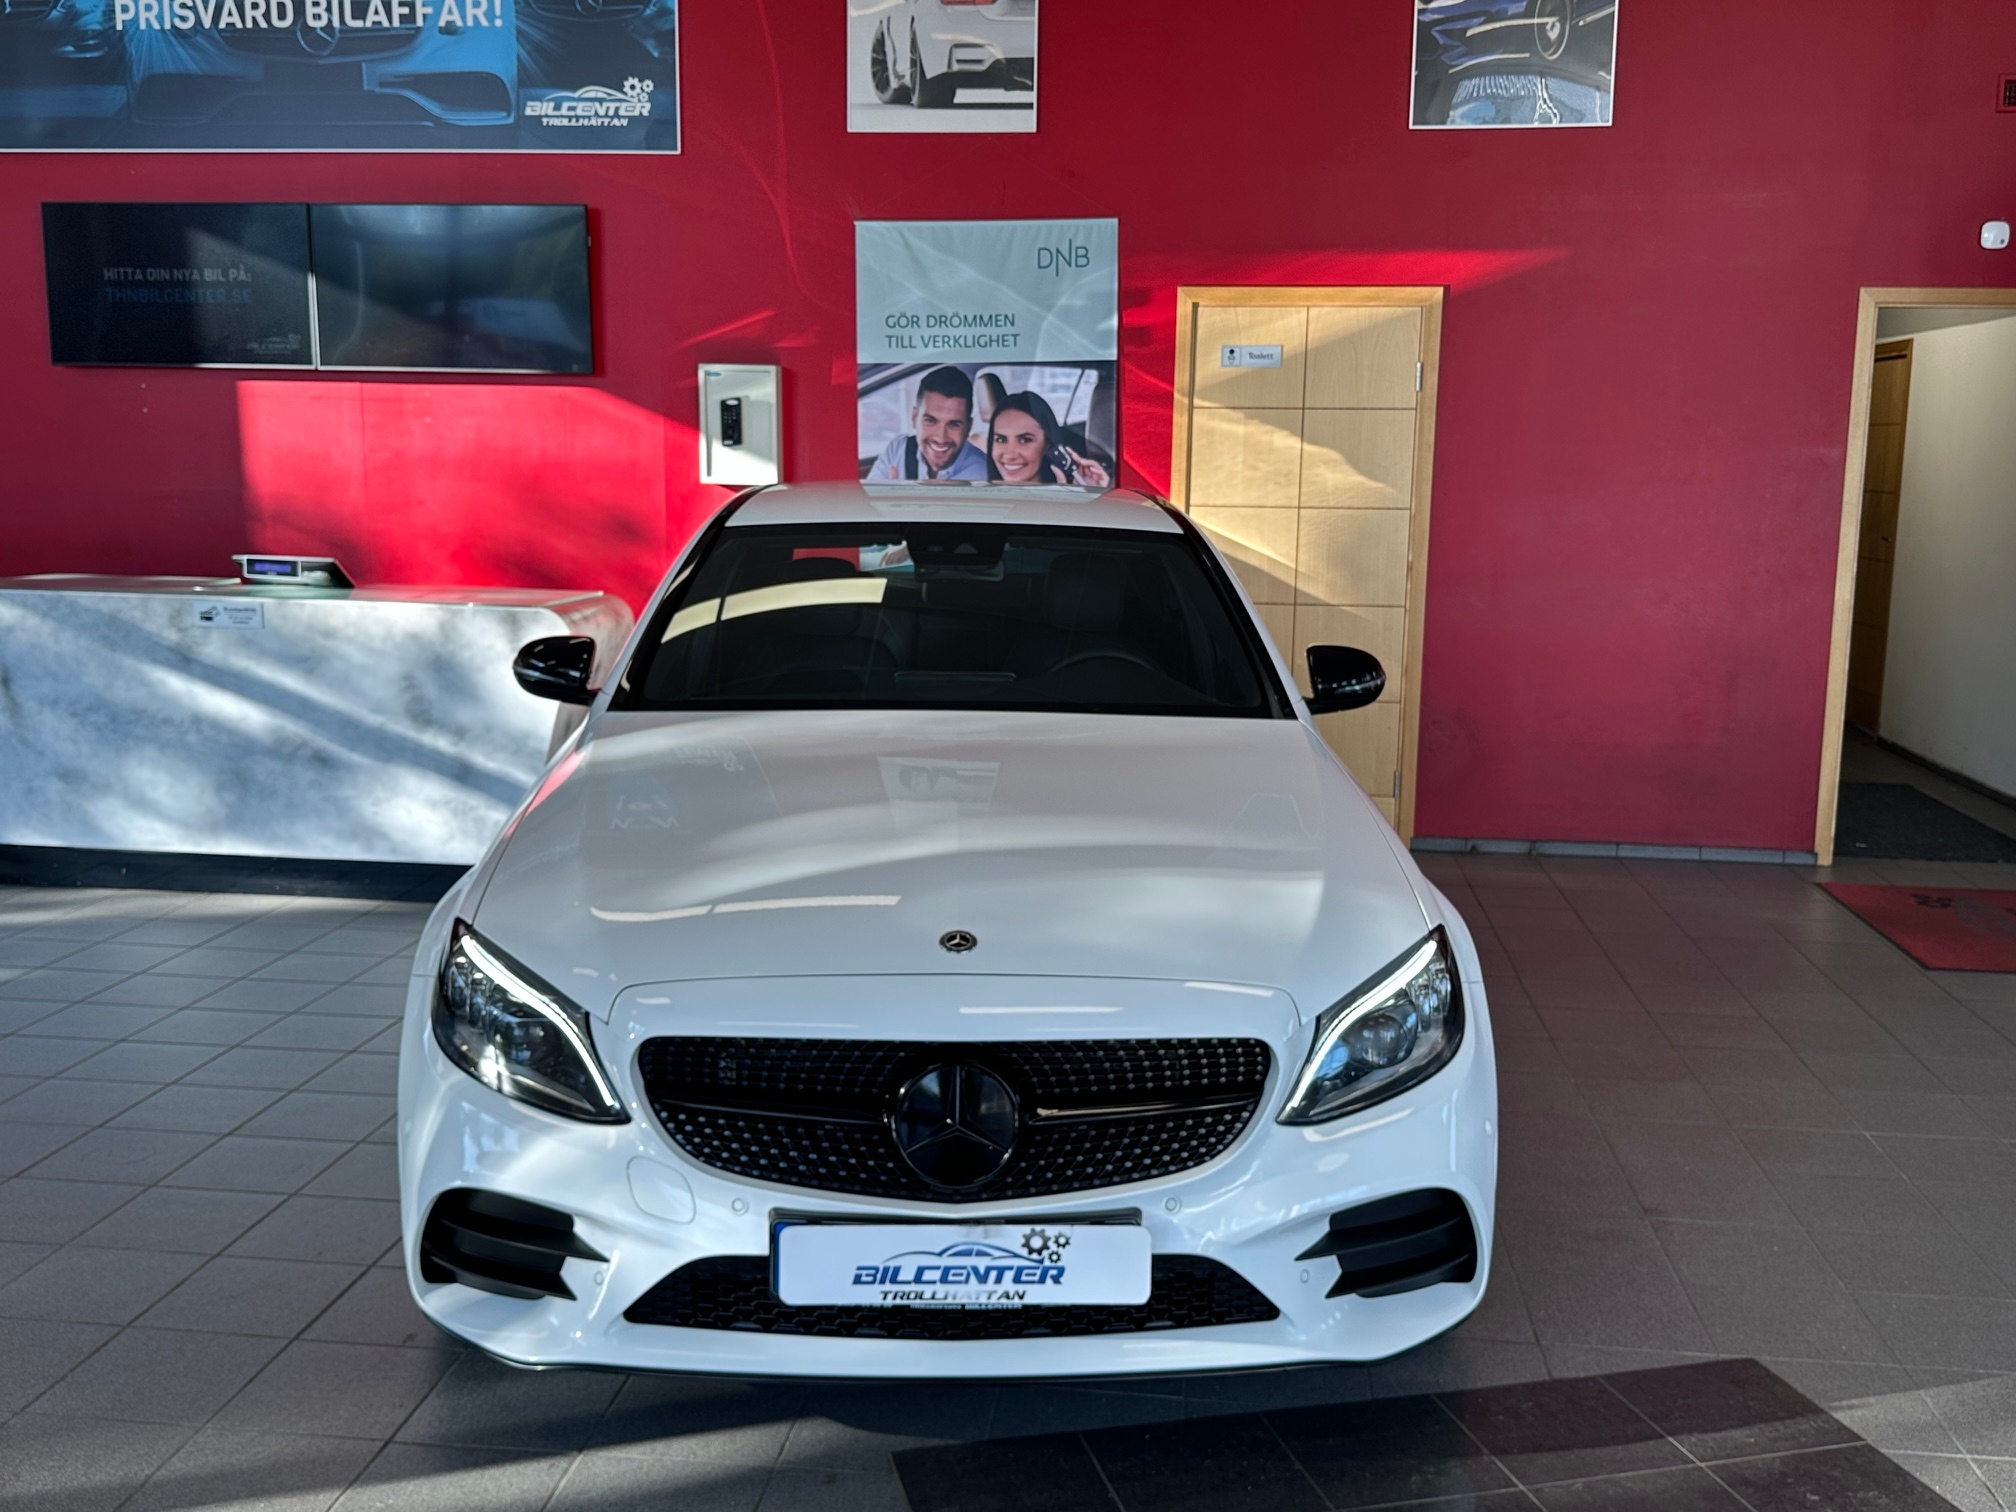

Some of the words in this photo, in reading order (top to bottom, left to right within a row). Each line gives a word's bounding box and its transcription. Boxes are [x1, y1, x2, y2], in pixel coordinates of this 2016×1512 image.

[524, 101, 652, 116] BILCENTER
[541, 116, 629, 127] TROLLHÄTTAN
[1037, 238, 1090, 277] DNB
[103, 266, 143, 281] HITTA
[146, 267, 170, 281] DIN
[173, 268, 201, 281] NYA
[203, 268, 226, 282] BIL
[885, 312, 921, 329] GÖR
[926, 312, 1016, 329] DRÖMMEN
[885, 335, 917, 348] TILL
[921, 334, 1020, 348] VERKLIGHET
[852, 1265, 1065, 1285] BILCENTER
